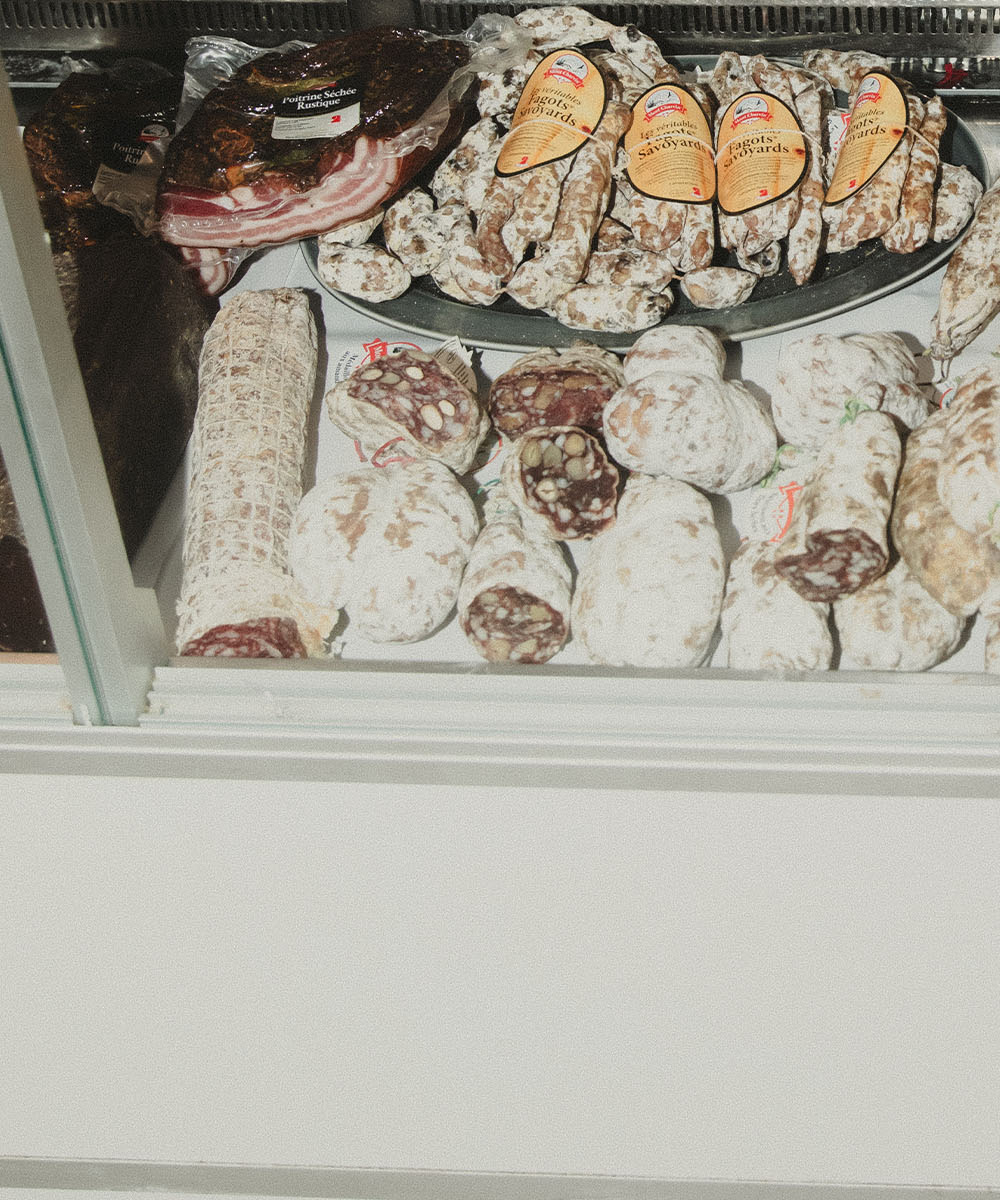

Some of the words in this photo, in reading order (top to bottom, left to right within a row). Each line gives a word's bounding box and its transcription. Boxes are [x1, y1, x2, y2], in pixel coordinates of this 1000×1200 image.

[282, 93, 323, 105] Poitrine
[323, 87, 357, 99] Séchée
[296, 98, 341, 111] Rustique
